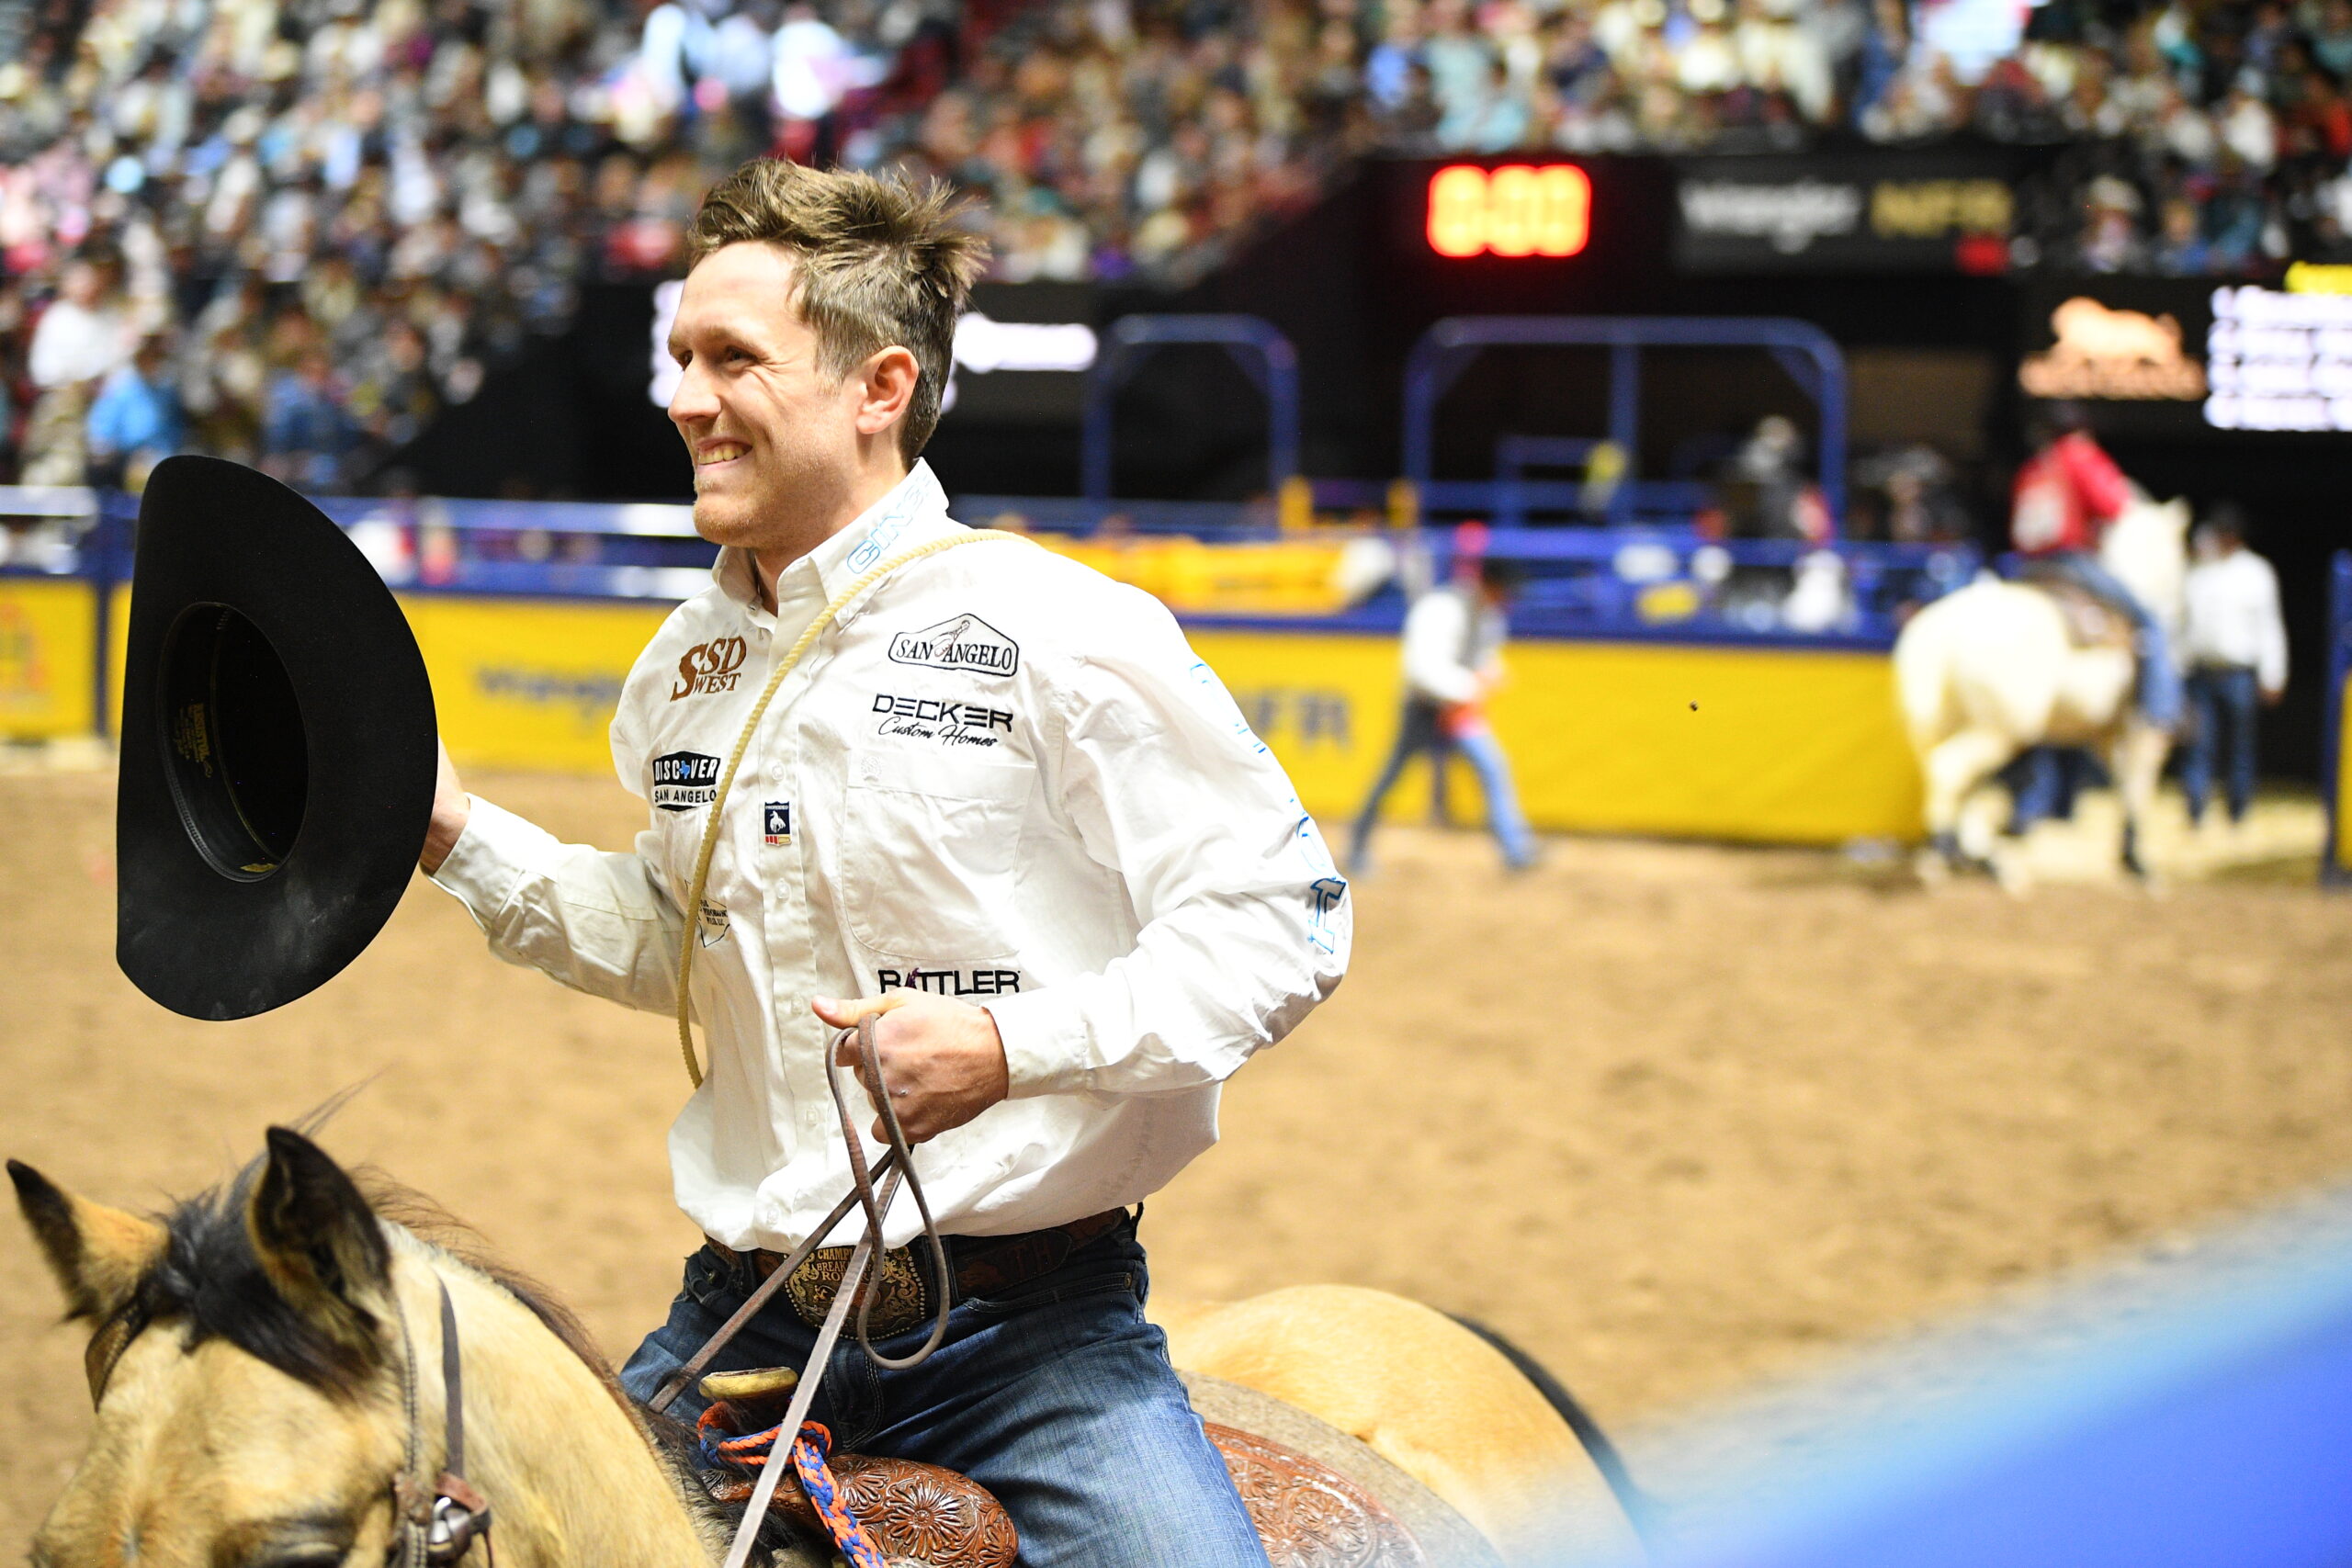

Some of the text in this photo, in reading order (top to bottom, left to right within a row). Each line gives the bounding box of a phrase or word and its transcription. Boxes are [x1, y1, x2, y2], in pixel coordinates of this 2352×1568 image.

[670, 635, 747, 703] SSD
[896, 638, 1012, 671] SAN ANGELO
[693, 672, 741, 694] WEST
[872, 693, 1013, 733] DECKER
[878, 716, 997, 747] Custom Homes
[654, 758, 718, 782] DISCVER
[654, 789, 718, 804] SAN ANGELO
[877, 967, 1021, 996] RATTLER
